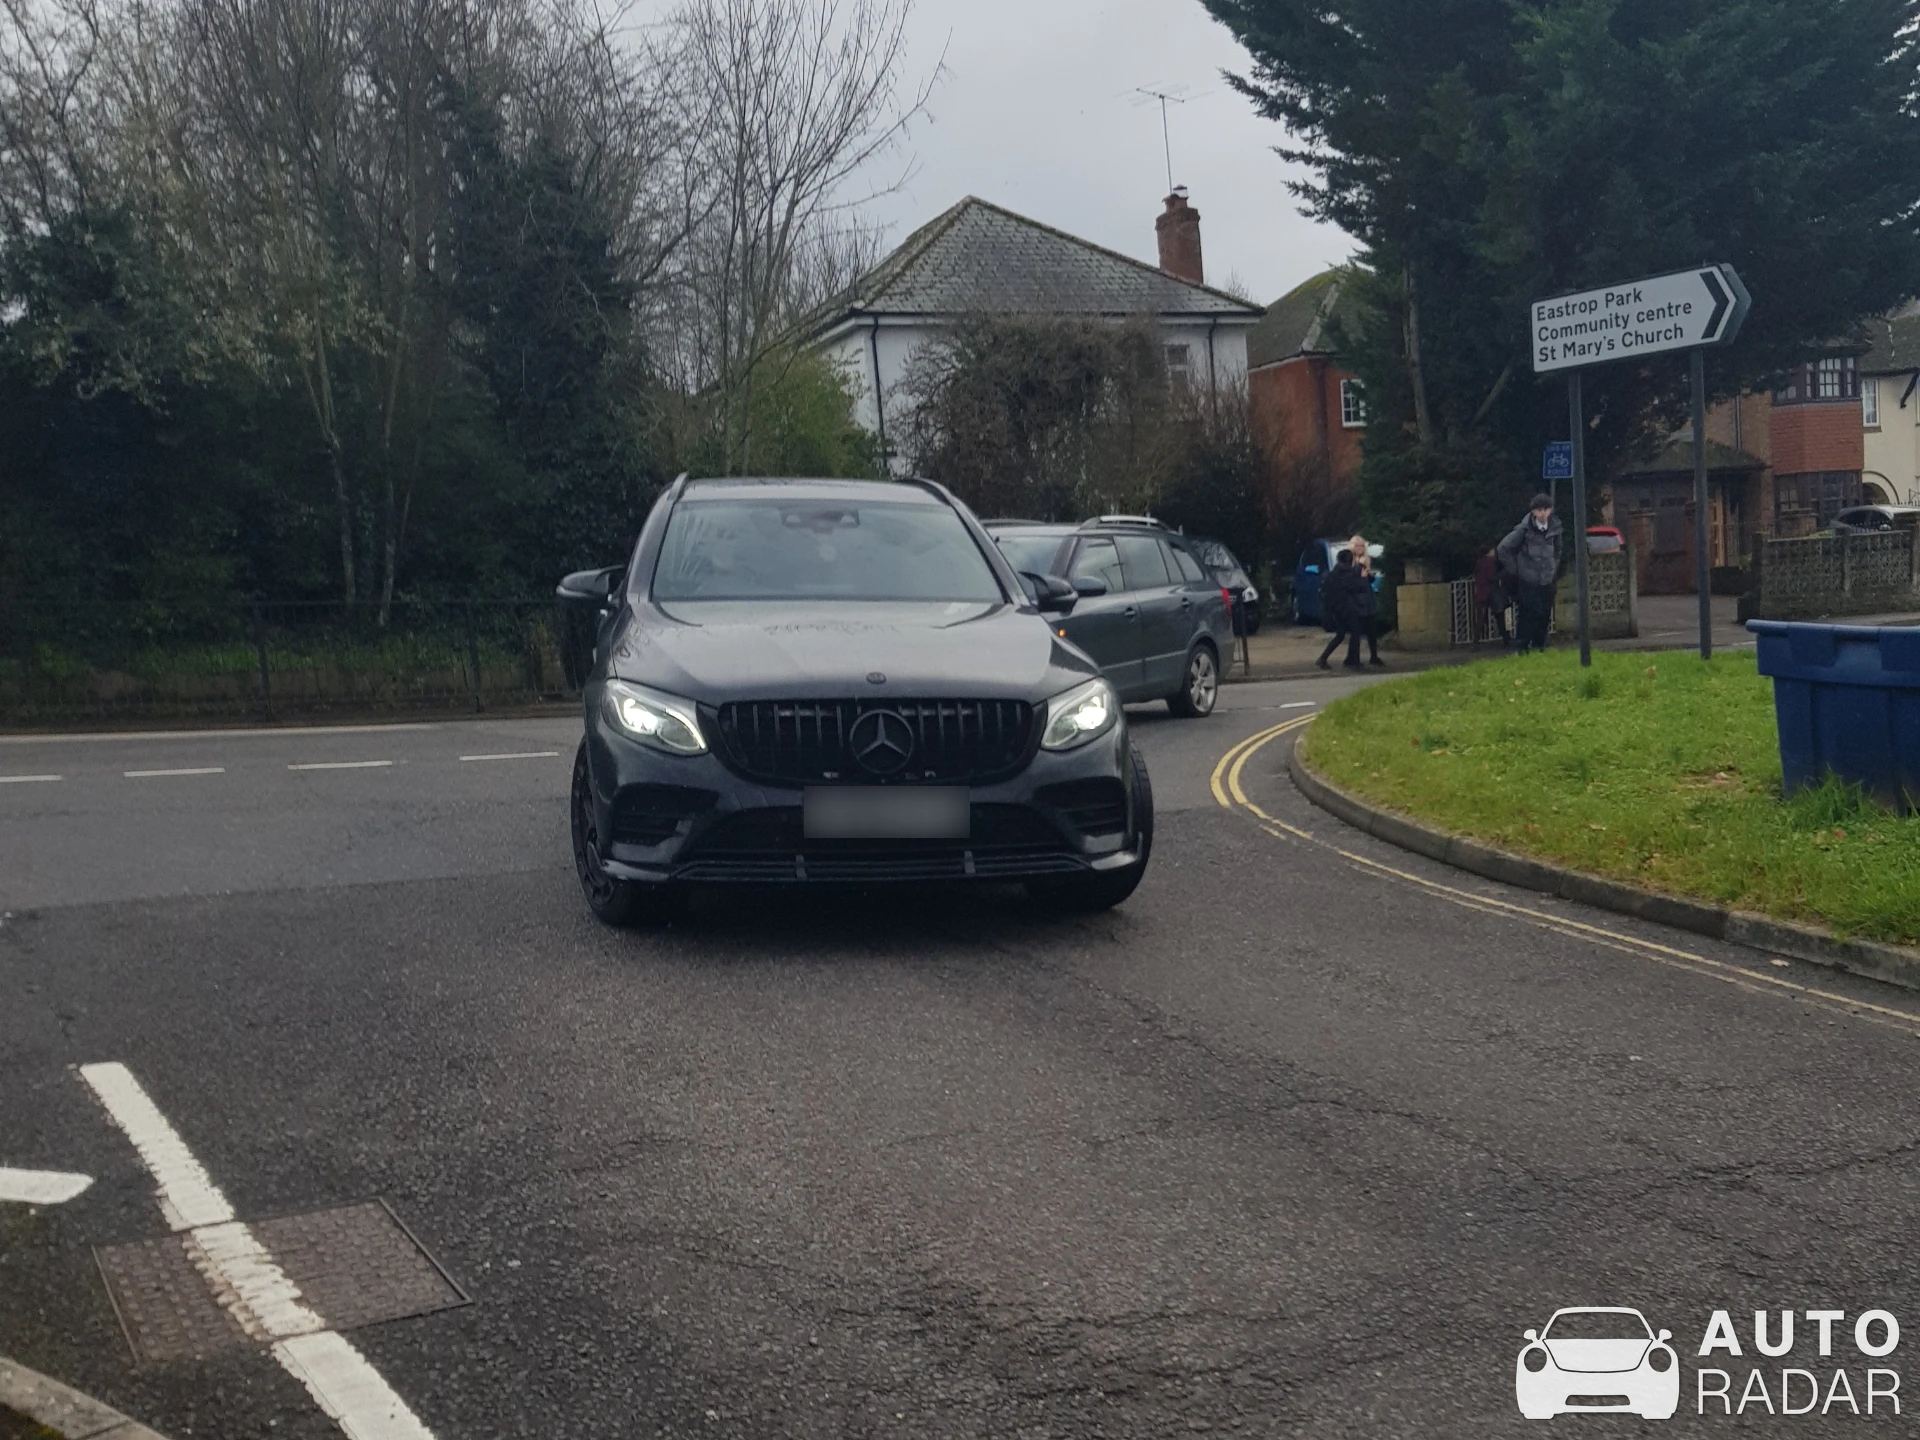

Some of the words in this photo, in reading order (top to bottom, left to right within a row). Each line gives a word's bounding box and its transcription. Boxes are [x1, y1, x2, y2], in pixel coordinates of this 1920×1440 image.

[1536, 300, 1598, 322] Eastrop
[1604, 287, 1643, 309] Park
[1538, 312, 1630, 342] Community
[1636, 302, 1692, 324] centre
[1538, 346, 1557, 363] St
[1562, 336, 1615, 359] Mary's
[1621, 323, 1684, 348] Church
